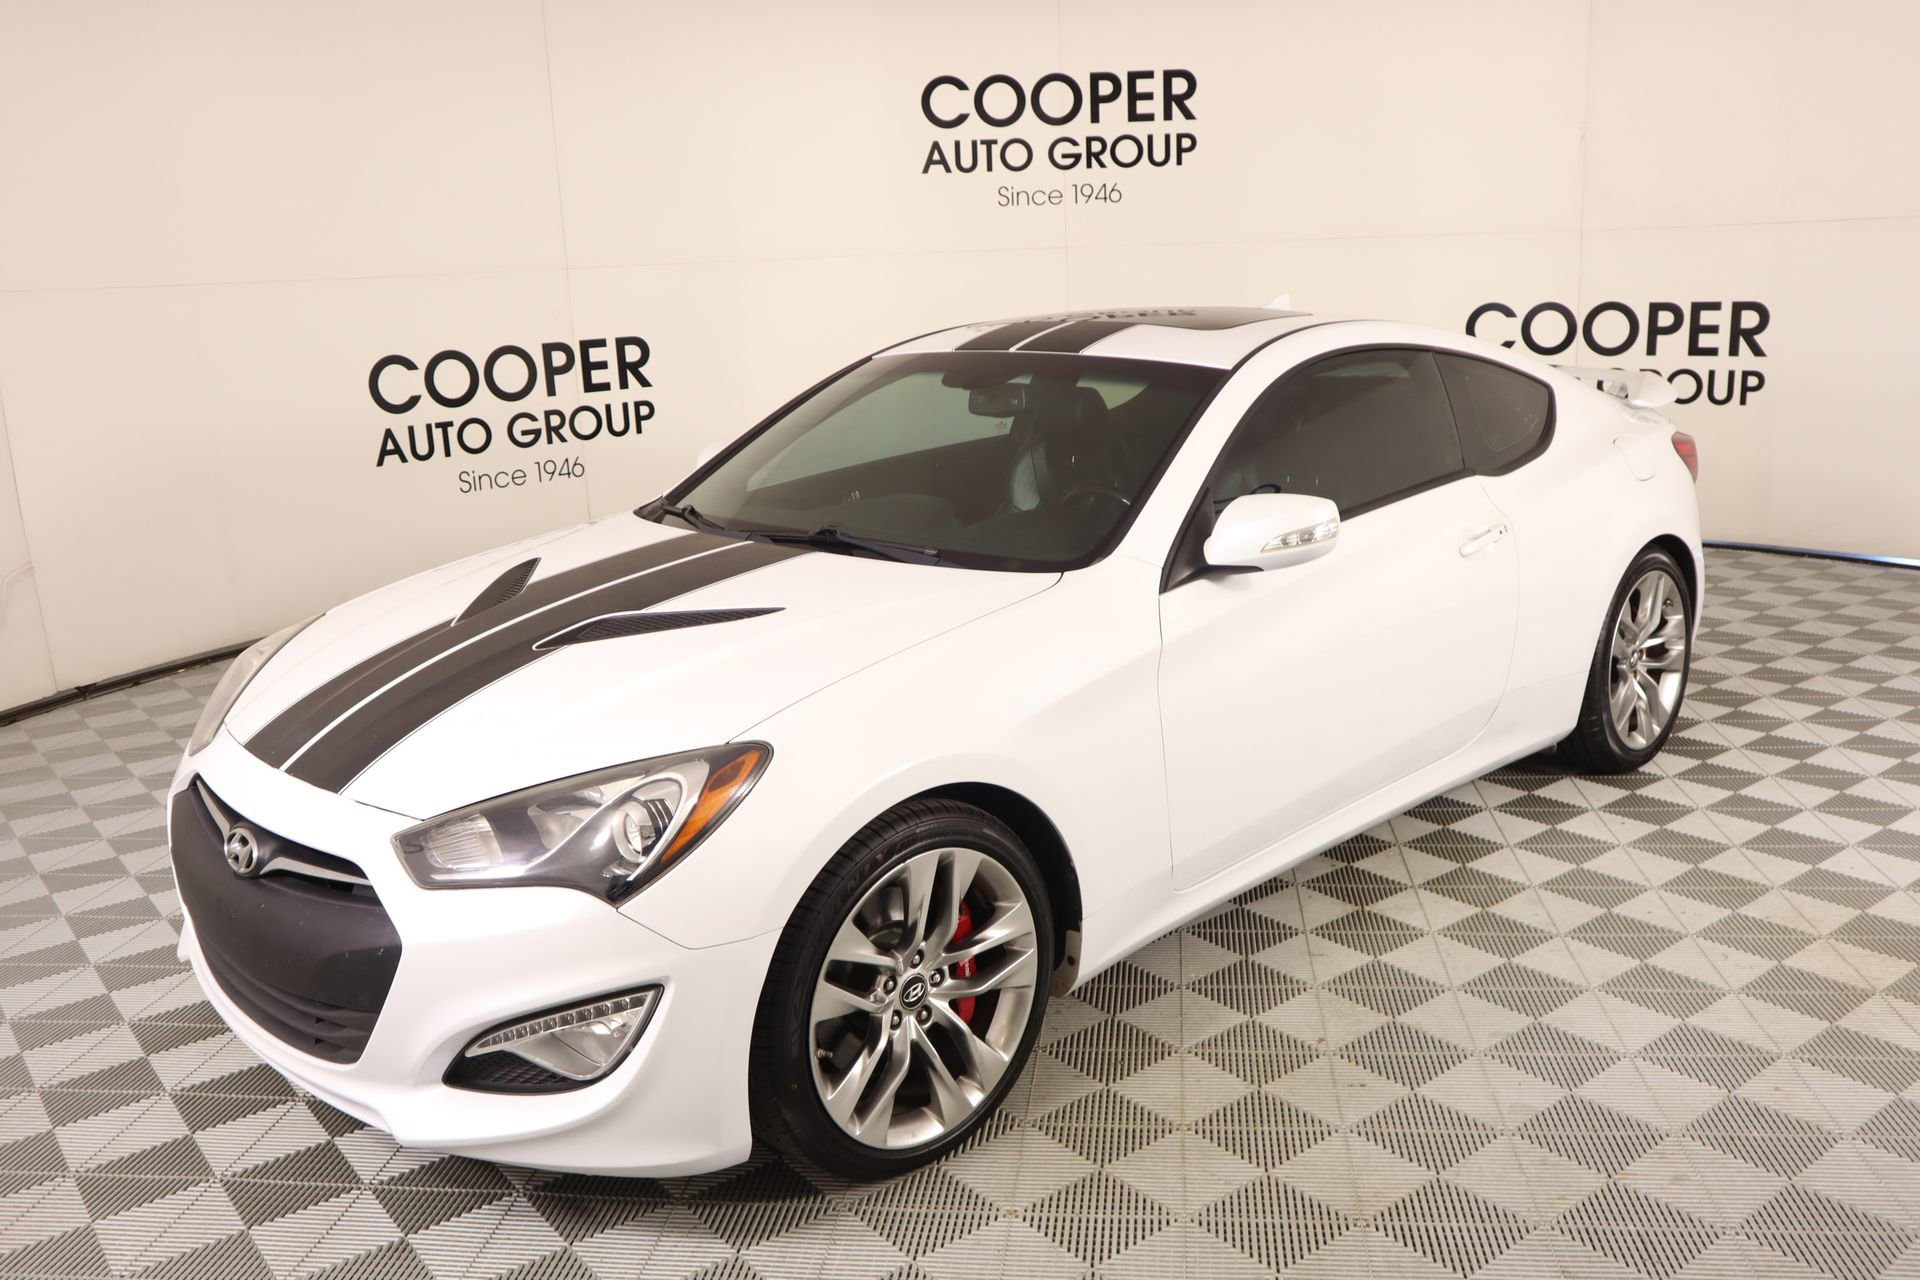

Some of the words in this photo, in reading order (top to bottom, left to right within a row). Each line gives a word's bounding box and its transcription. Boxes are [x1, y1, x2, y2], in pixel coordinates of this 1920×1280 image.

[920, 69, 1198, 129] COOPER
[921, 137, 1034, 174] AUTO
[1047, 132, 1198, 171] GROUP
[997, 185, 1064, 208] Since
[1071, 182, 1123, 205] 1946
[1465, 301, 1770, 357] COOPER
[368, 336, 653, 415] COOPER
[376, 417, 493, 467] AUTO
[506, 399, 656, 449] GROUP
[458, 469, 527, 494] Since
[534, 456, 586, 483] 1946
